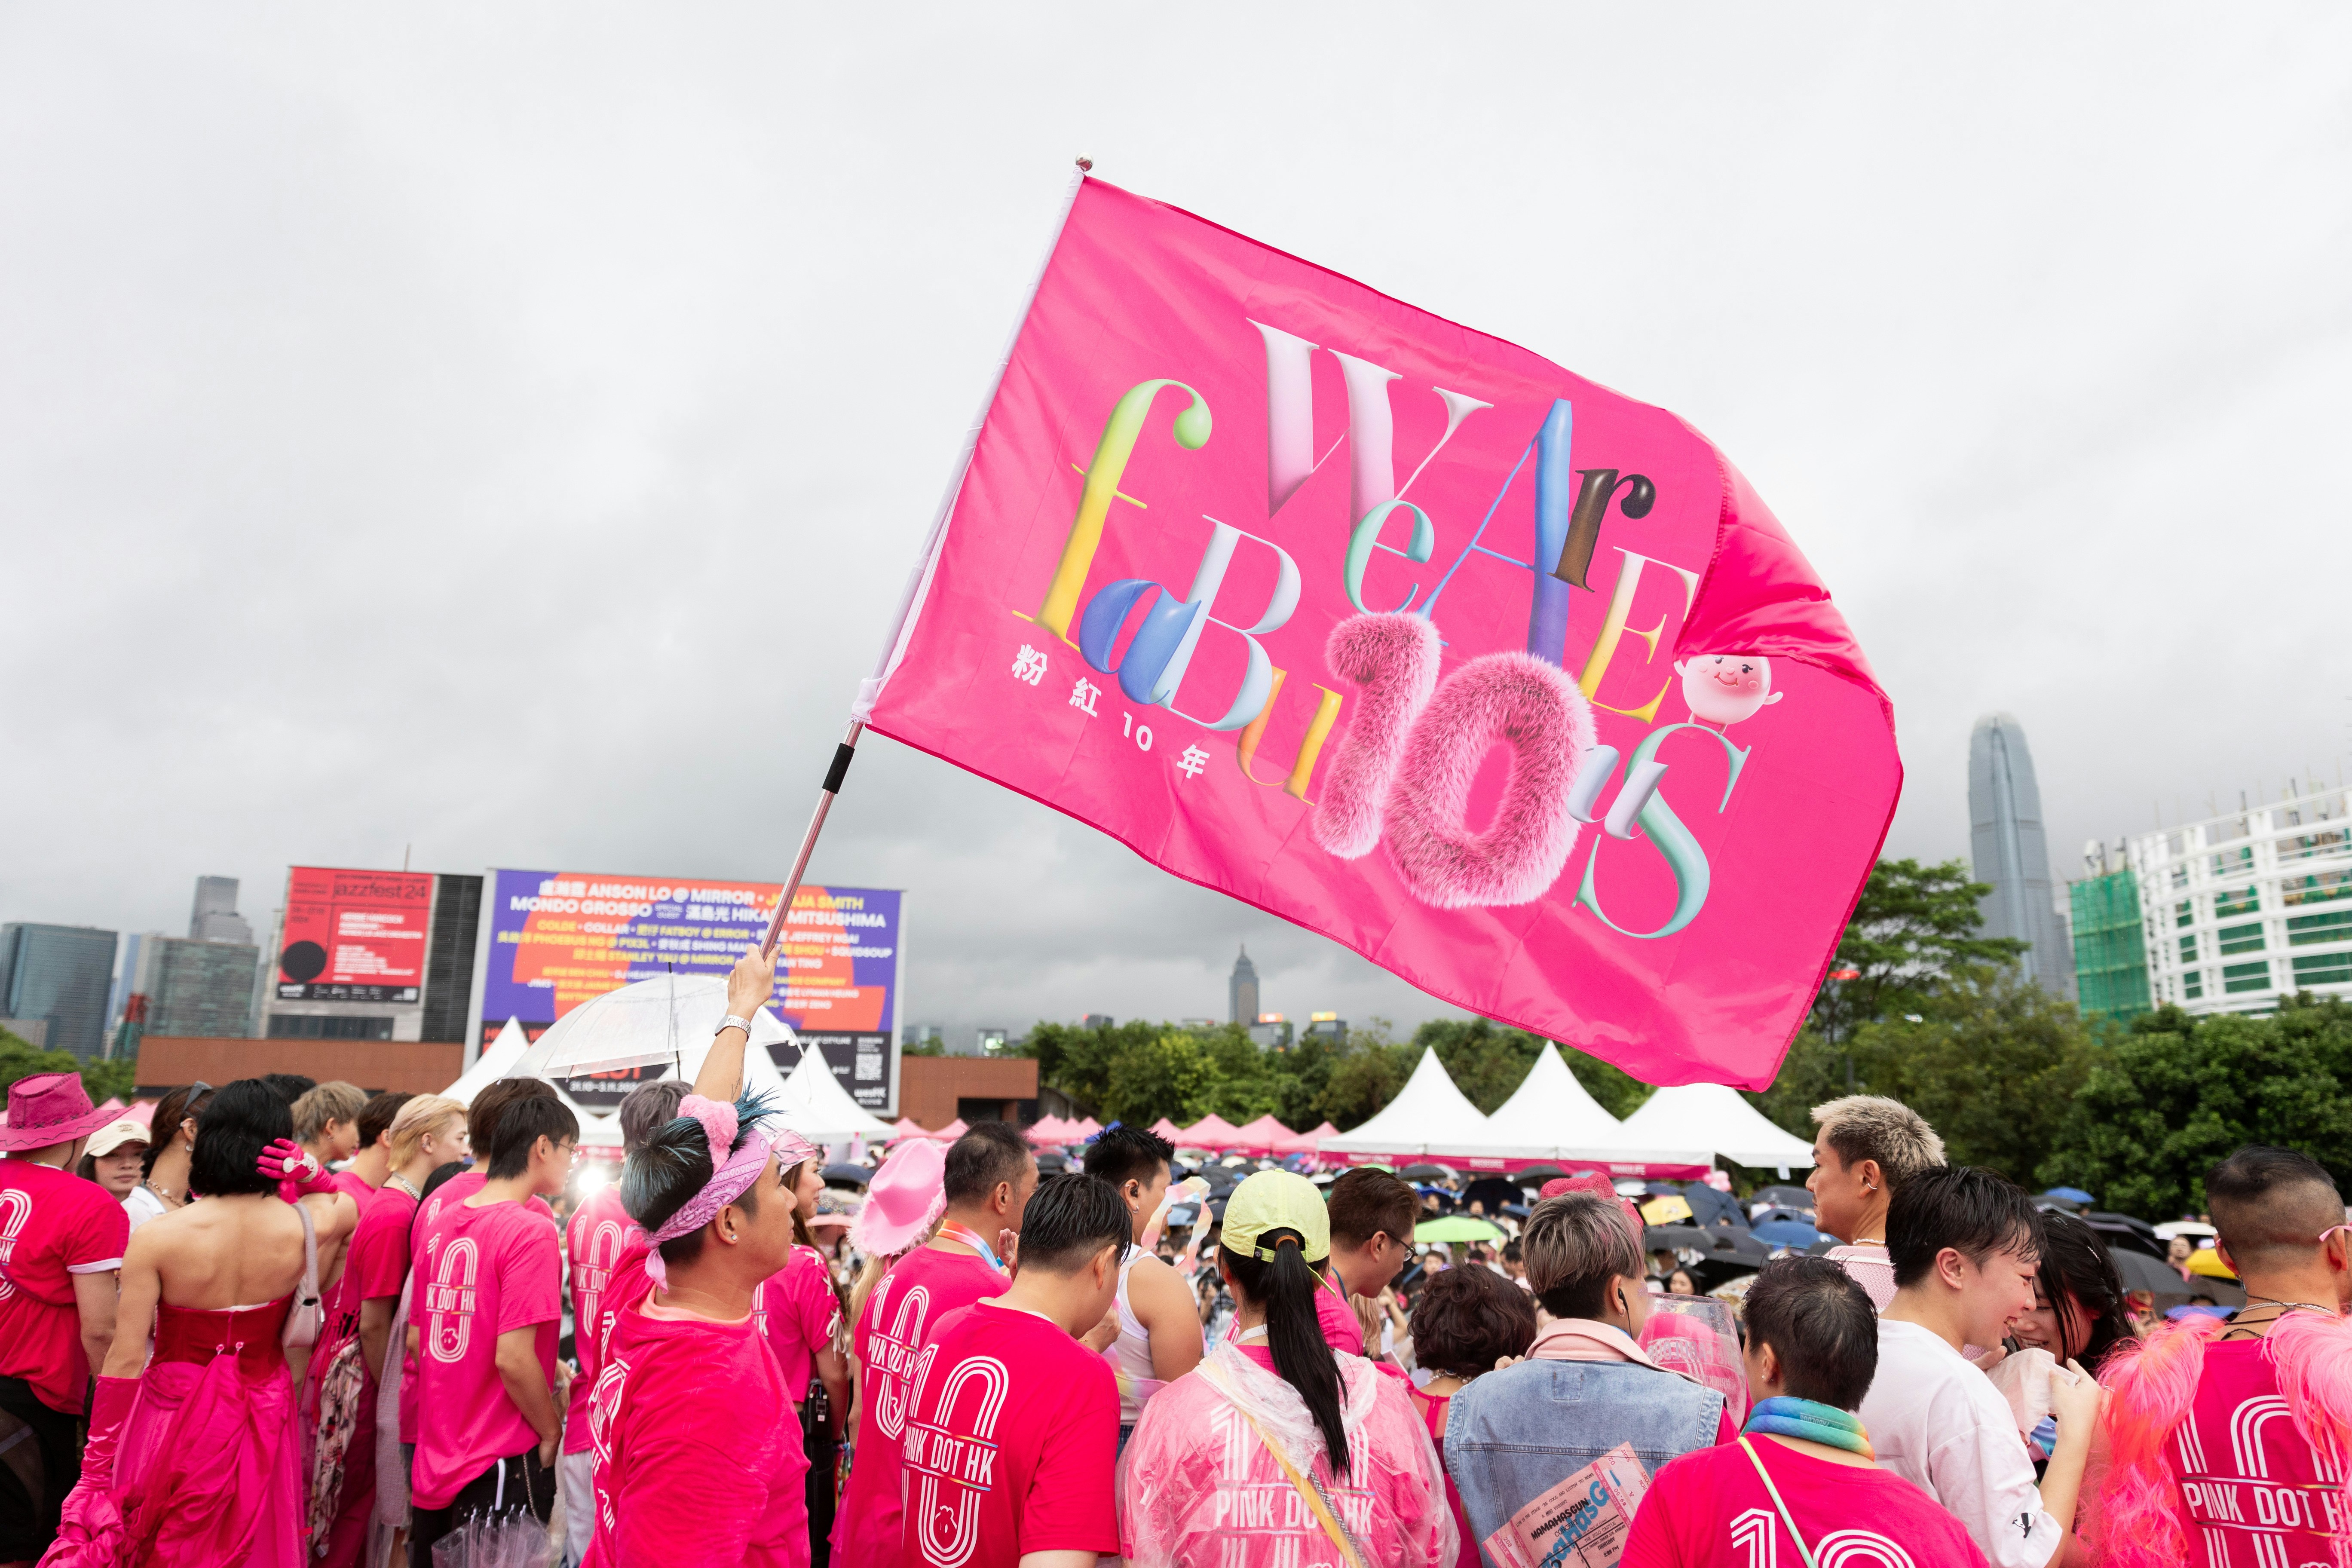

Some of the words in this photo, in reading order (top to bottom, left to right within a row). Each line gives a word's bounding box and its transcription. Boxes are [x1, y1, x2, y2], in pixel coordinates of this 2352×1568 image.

[404, 884, 426, 900] 24
[587, 882, 647, 900] ANSON
[648, 885, 672, 901] LO
[672, 887, 689, 903] @
[690, 888, 756, 906] MIRROR
[766, 893, 816, 908] JJA
[817, 895, 864, 910] SMITH
[510, 896, 579, 913] MONDO
[580, 899, 652, 918] GROSSO
[732, 907, 775, 923] HIKA
[787, 910, 886, 928] MITSUSHIMA
[583, 921, 630, 934] COLLAR
[659, 925, 701, 937] FATBOY
[701, 927, 713, 939] @
[788, 931, 833, 943] JEFFREY
[606, 936, 618, 948] @
[691, 940, 727, 952] SHING
[727, 941, 748, 953] MA
[607, 949, 655, 963] STANLEY
[679, 953, 690, 965] @
[691, 954, 735, 965] MIRROR
[830, 946, 893, 959] SQUIDSOUP
[591, 1268, 606, 1293] DOT
[437, 1288, 458, 1311] DOT
[903, 1352, 919, 1379] H
[902, 1424, 929, 1465] PINK
[930, 1436, 965, 1475] DOT
[963, 1444, 997, 1485] HK
[1608, 1456, 1615, 1465] 02
[1621, 1449, 1631, 1462] SEAT
[1638, 1479, 1647, 1491] ROW
[1641, 1471, 1651, 1486] CONY
[1531, 1506, 1541, 1516] STAGE
[1565, 1482, 1578, 1492] LISTEN
[1554, 1499, 1568, 1511] PRESENT
[1614, 1488, 1627, 1507] $9.50
[2181, 1482, 2245, 1524] PINK
[2252, 1486, 2315, 1529] DOT
[1216, 1490, 1273, 1528] PINK
[1344, 1497, 1373, 1534] HK
[1531, 1497, 1590, 1541] MAMAHASGUN
[1554, 1519, 1579, 1537] CONCERT
[1602, 1522, 1616, 1532] CASTLE
[1496, 1539, 1509, 1555] AISLE
[1503, 1537, 1512, 1547] 208
